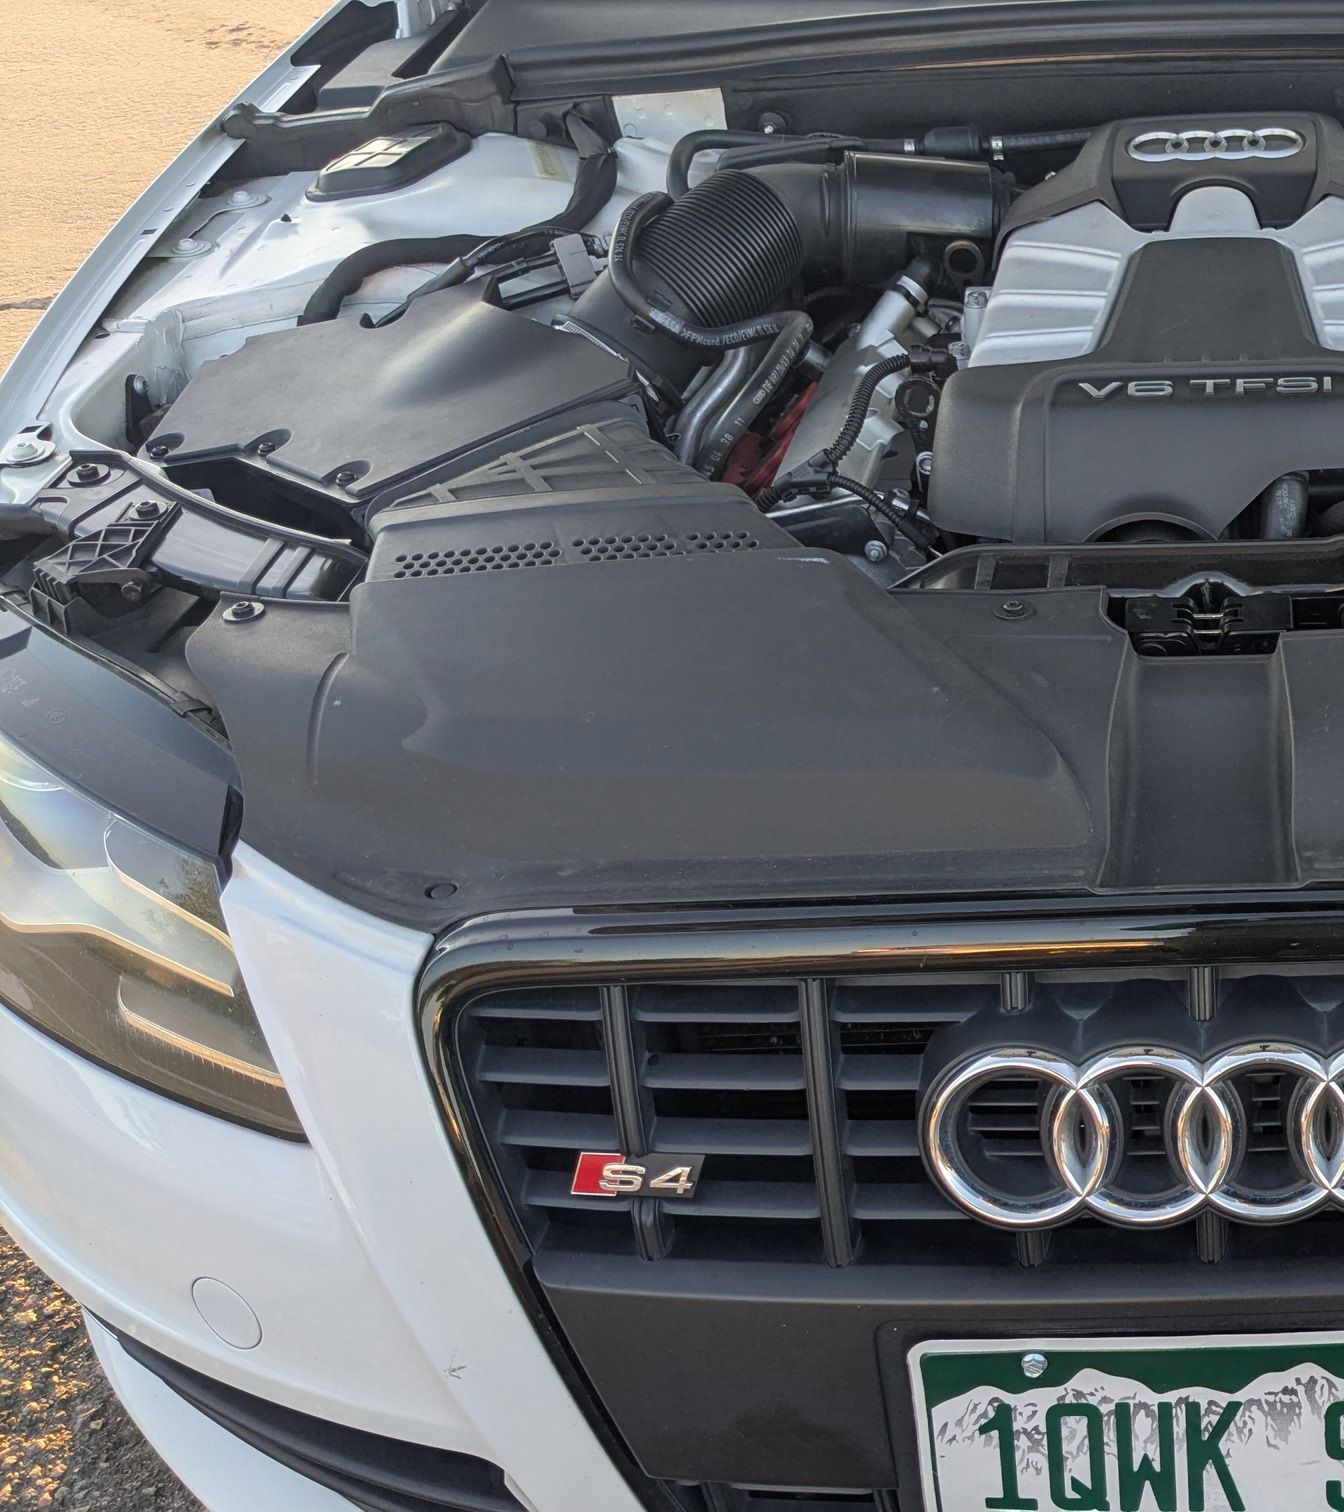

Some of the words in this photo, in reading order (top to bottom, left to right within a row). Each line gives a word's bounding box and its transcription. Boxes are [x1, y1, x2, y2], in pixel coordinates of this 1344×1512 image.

[1078, 379, 1174, 399] V6
[1190, 376, 1332, 396] TFSI
[598, 1163, 693, 1195] S4
[979, 1401, 1246, 1512] 1QWK
